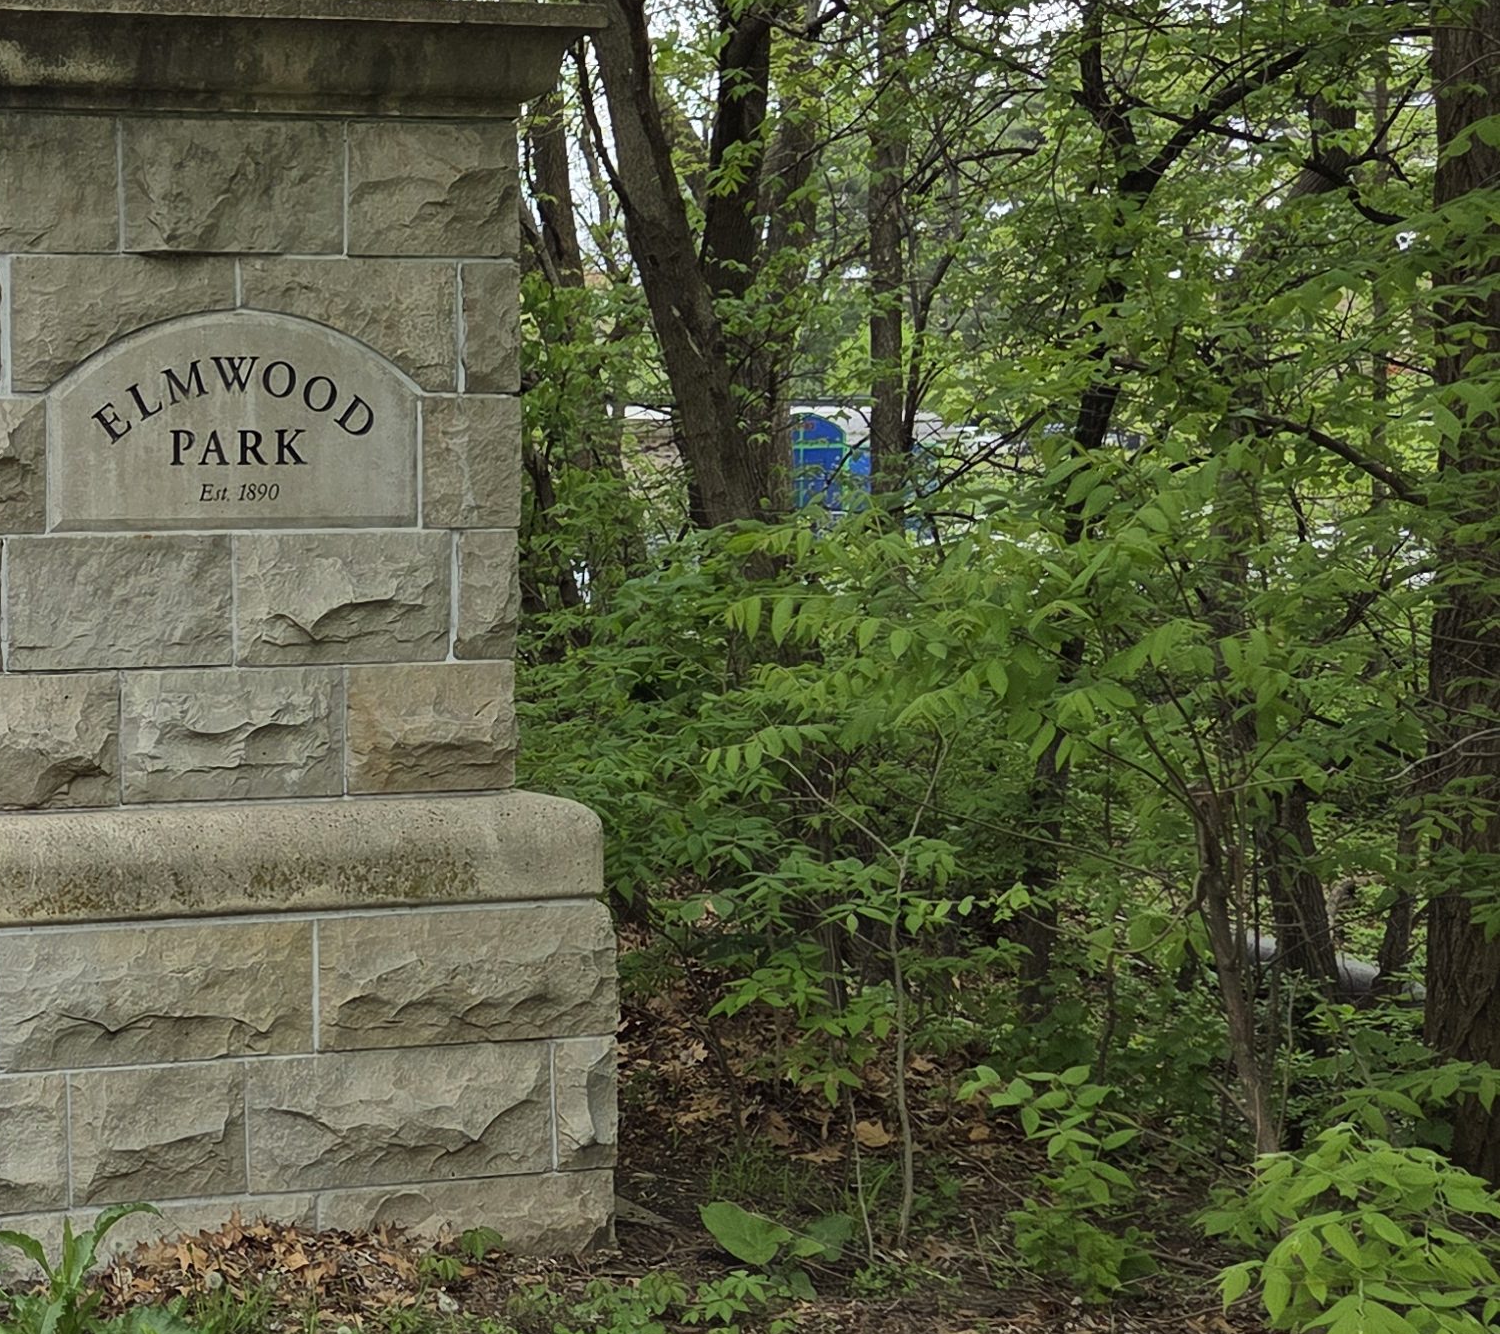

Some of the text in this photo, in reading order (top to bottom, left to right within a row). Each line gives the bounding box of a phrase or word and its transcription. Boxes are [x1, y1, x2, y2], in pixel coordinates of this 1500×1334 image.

[91, 356, 375, 445] ELMWOOD
[169, 429, 308, 466] PARK
[199, 483, 280, 503] Est. 1890
